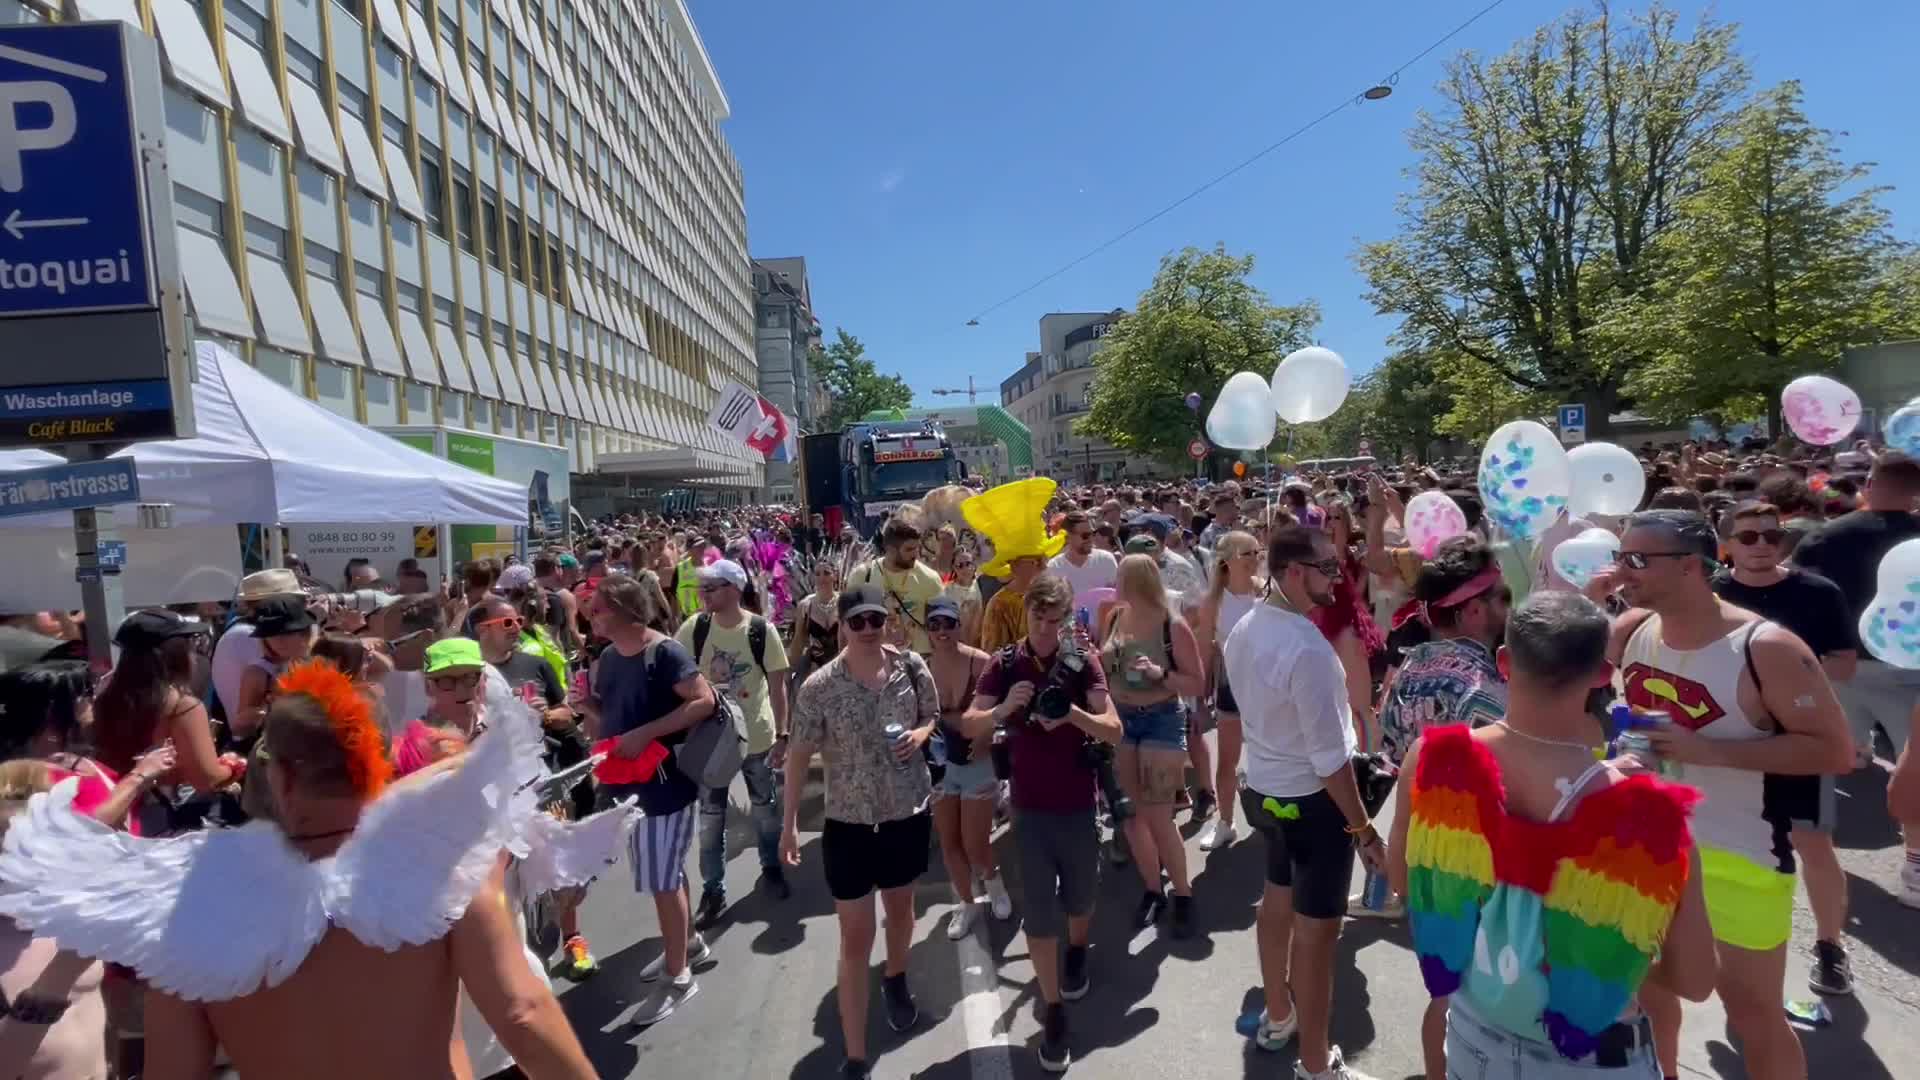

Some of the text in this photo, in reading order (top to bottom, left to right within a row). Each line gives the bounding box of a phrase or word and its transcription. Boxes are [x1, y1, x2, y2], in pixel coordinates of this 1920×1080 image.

[0, 81, 77, 192] P
[5, 389, 134, 410] Waschanlage
[28, 416, 115, 439] Café Black
[1567, 410, 1578, 425] P
[0, 473, 129, 505] Färrstrasse
[308, 532, 395, 543] 0848 80 80 99
